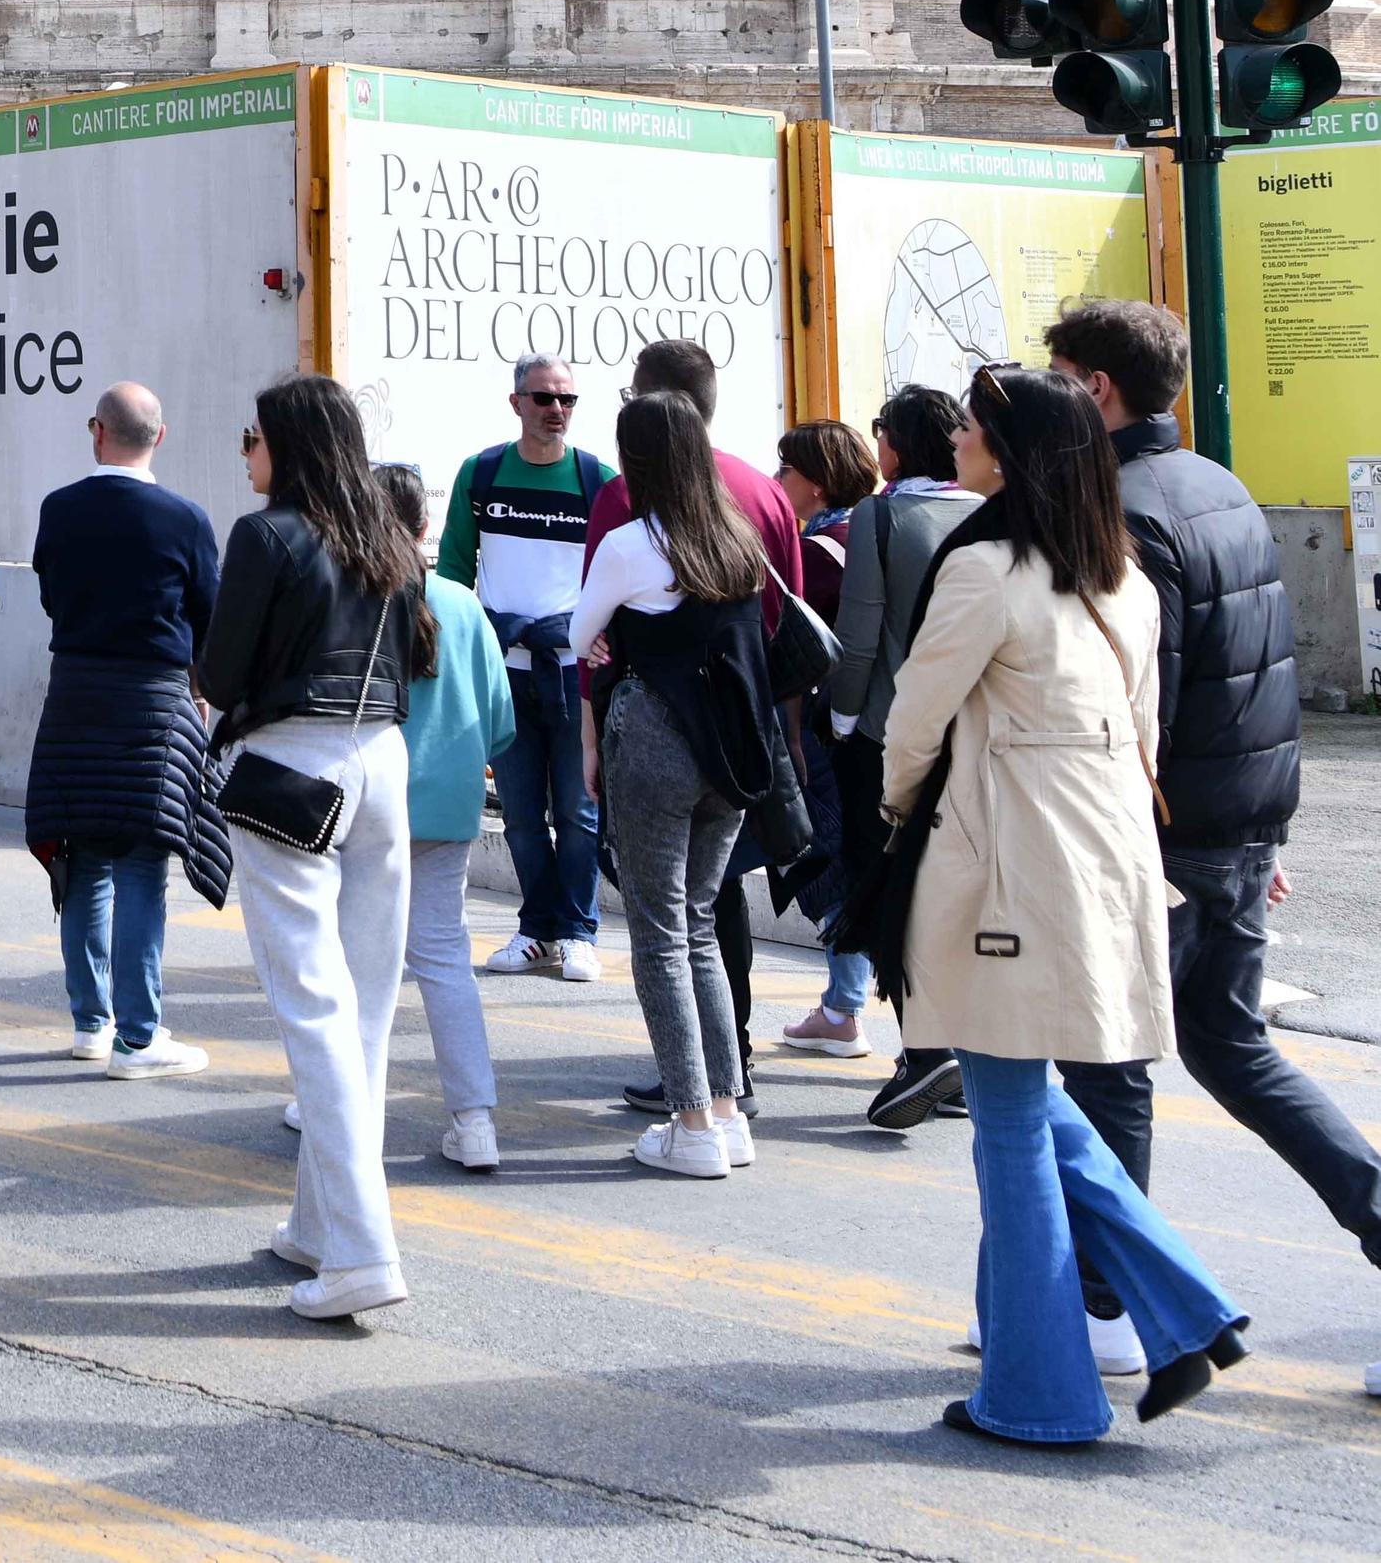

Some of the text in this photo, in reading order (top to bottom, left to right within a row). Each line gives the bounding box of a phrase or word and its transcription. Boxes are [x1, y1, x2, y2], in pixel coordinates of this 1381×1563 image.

[72, 85, 292, 136] CANTIERE FORI IMPERIALI
[485, 97, 691, 141] CANTIERE FORI IMPERIALI
[858, 146, 1106, 182] LINEA C DELLA METROPOLITANA DI ROMA
[1258, 172, 1333, 195] biglietti
[379, 226, 773, 307] ARCHEOLOGICO
[382, 296, 480, 362] DEL
[1278, 317, 1314, 325] Experience
[487, 502, 588, 528] Champion
